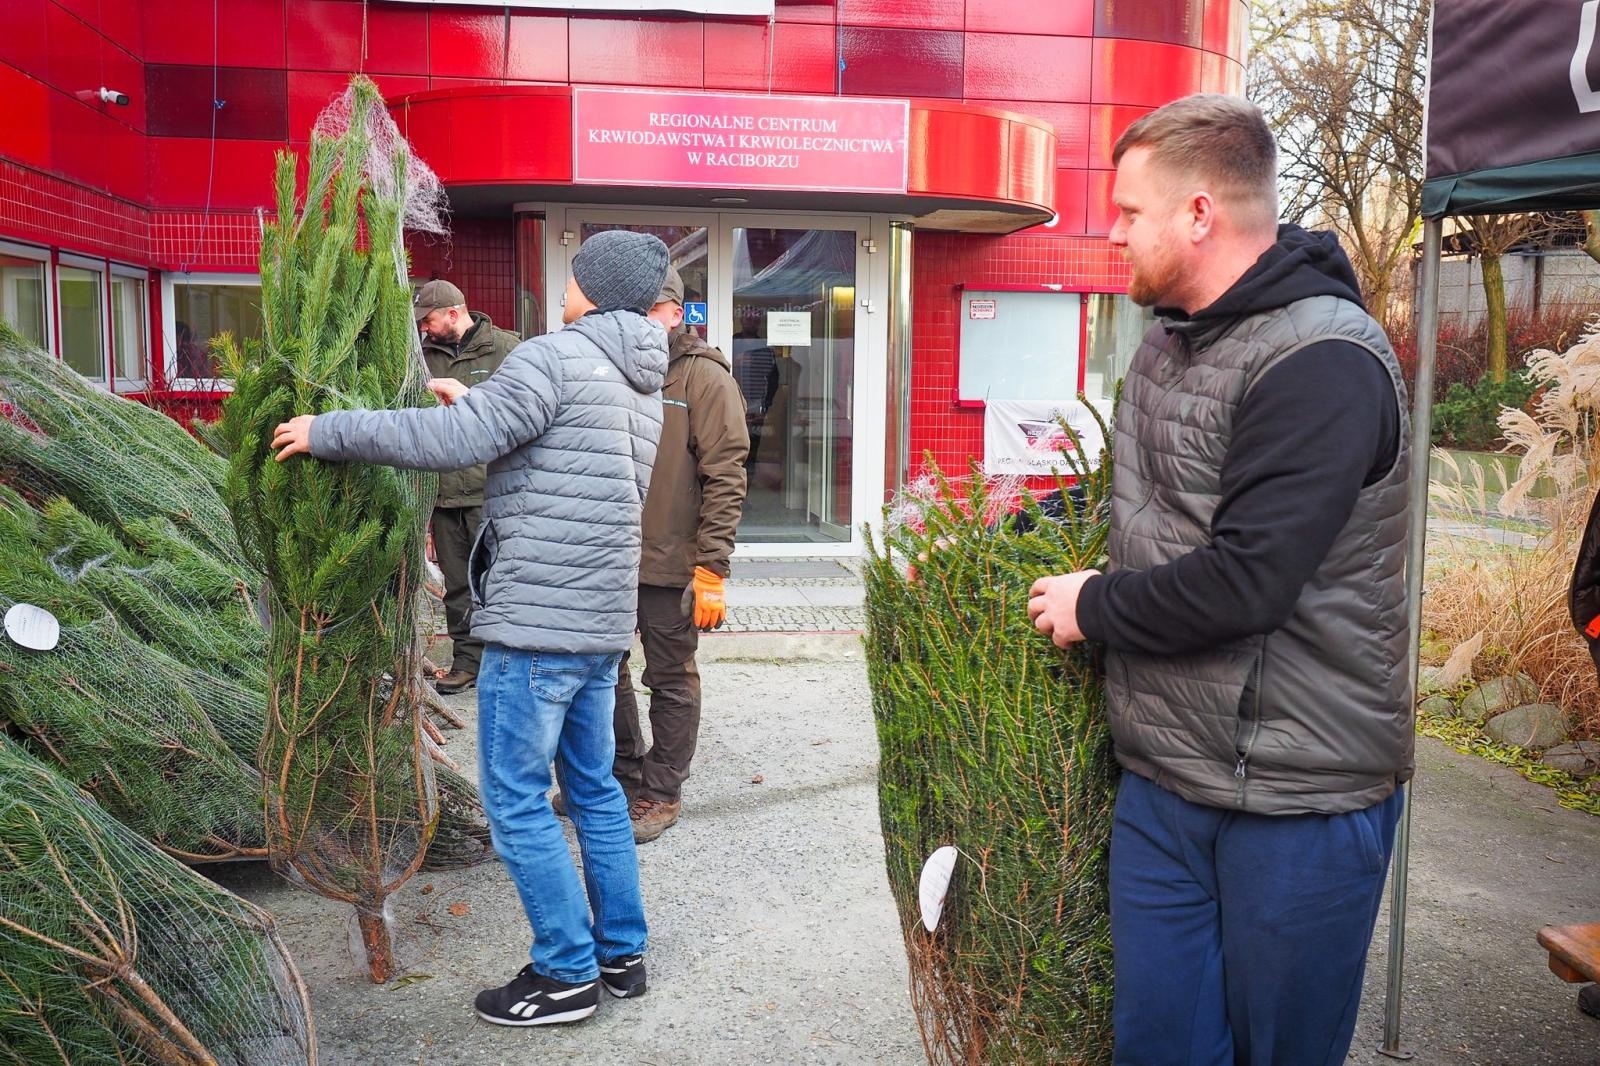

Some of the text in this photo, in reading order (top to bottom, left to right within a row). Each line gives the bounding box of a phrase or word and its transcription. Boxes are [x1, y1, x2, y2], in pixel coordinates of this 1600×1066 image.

[649, 112, 837, 133] REGIONALNE CENTRUM
[588, 128, 894, 153] KRWIODAWSTWA I KRWIOLECZNICTWA
[687, 151, 799, 168] W RACIBORZU
